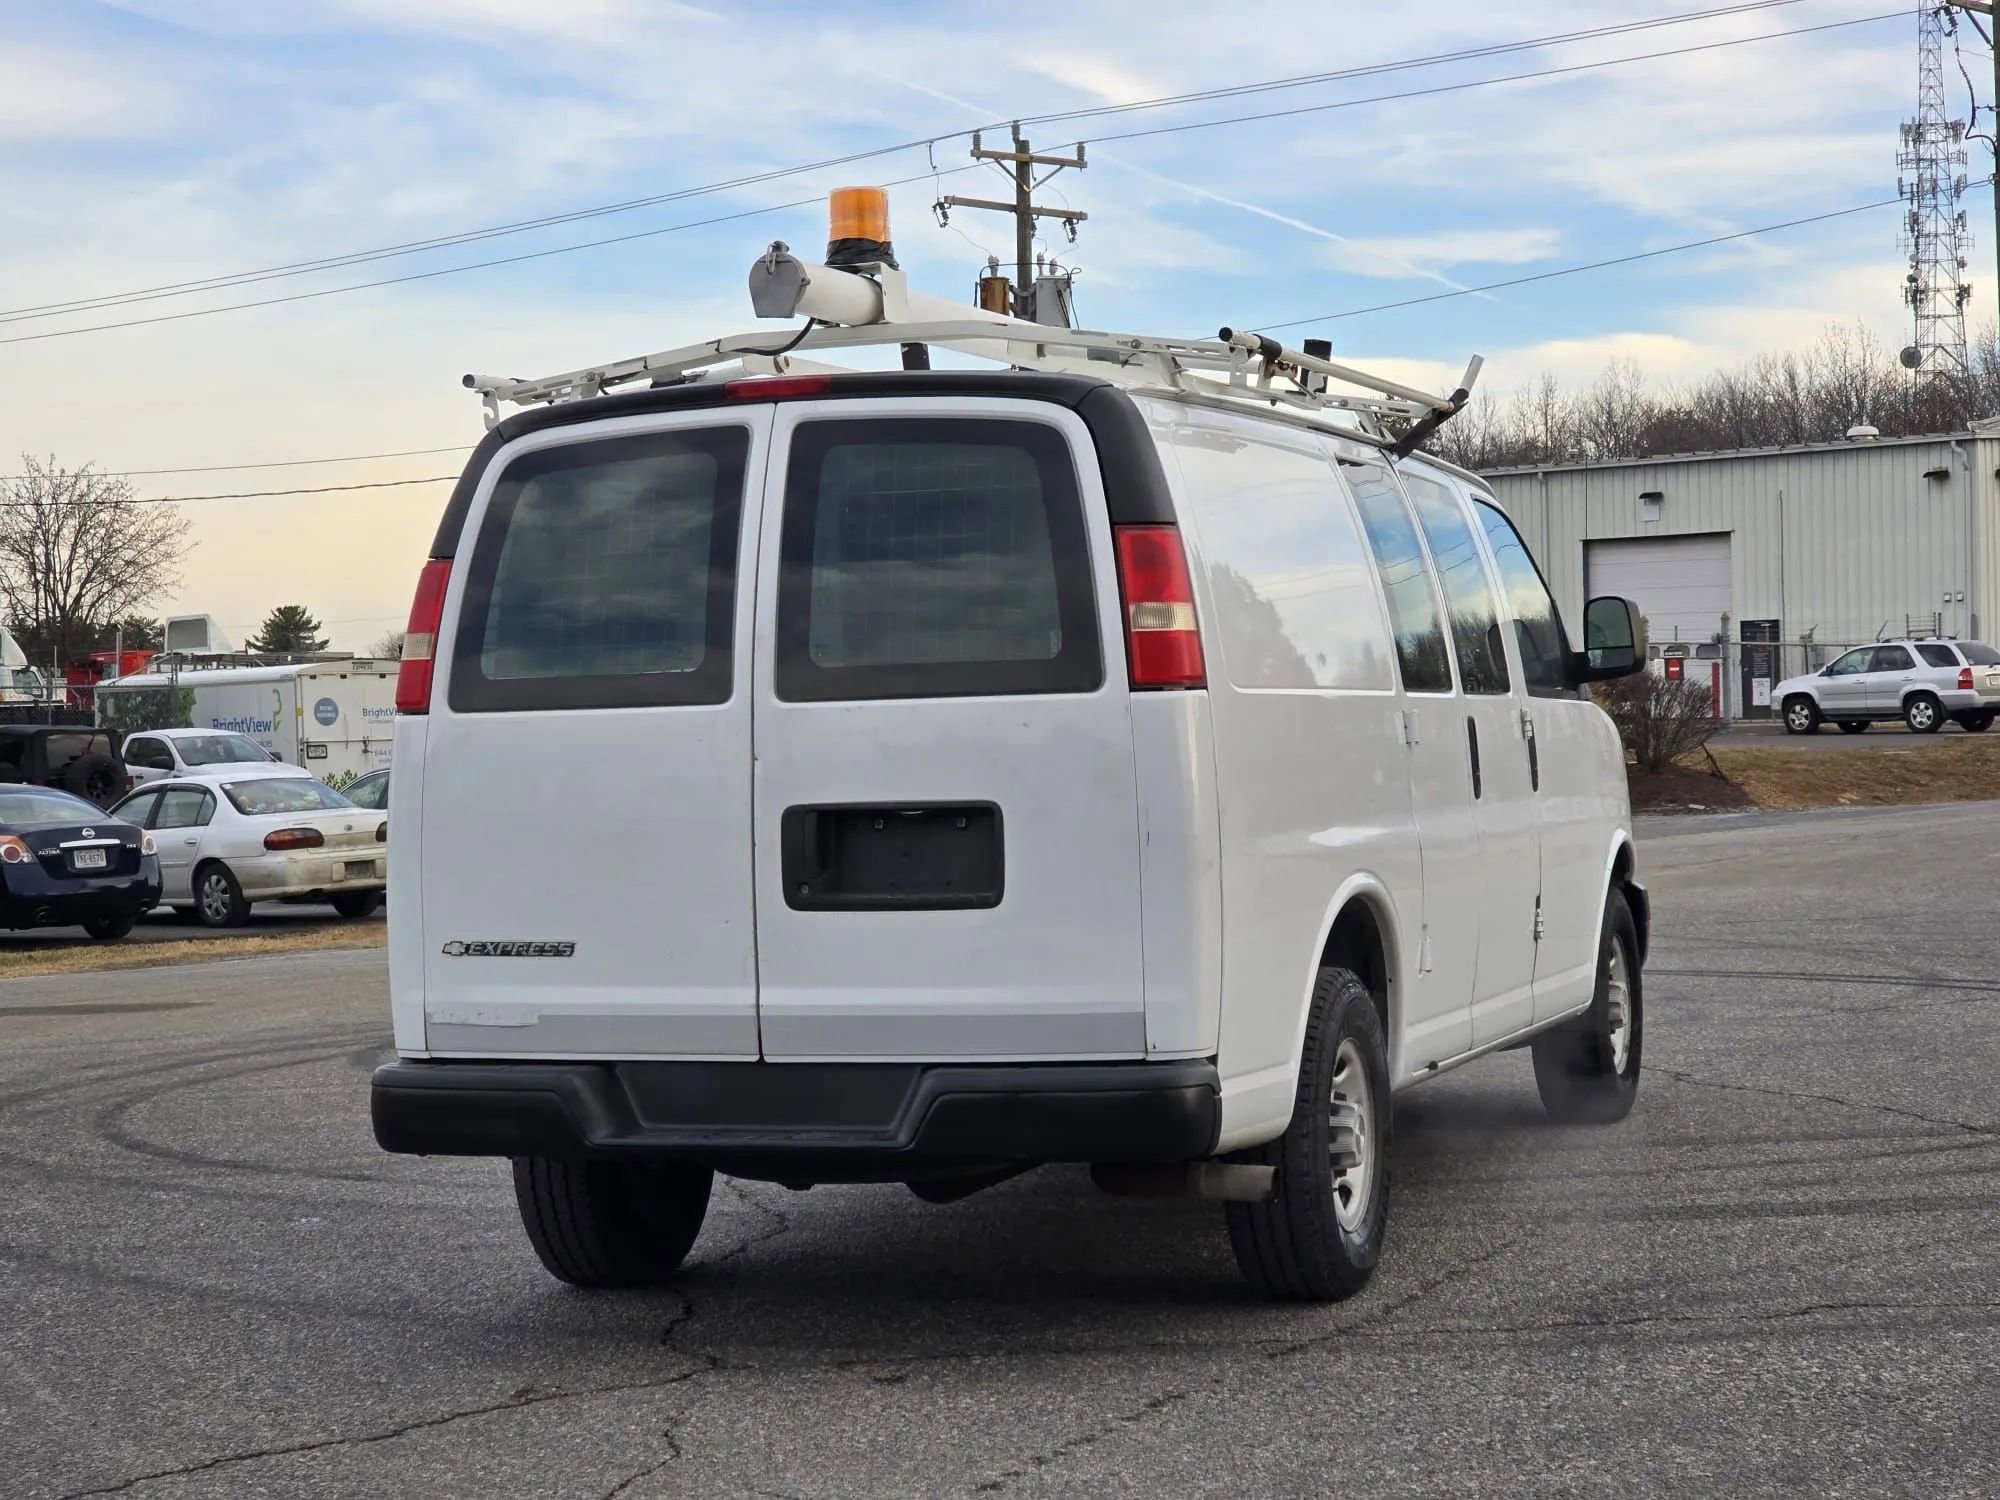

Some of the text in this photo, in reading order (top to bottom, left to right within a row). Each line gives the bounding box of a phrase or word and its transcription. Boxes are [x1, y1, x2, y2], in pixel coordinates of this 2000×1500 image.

[362, 707, 398, 719] BrightVi
[212, 717, 272, 733] BrightView
[468, 941, 575, 956] EXPRESS
